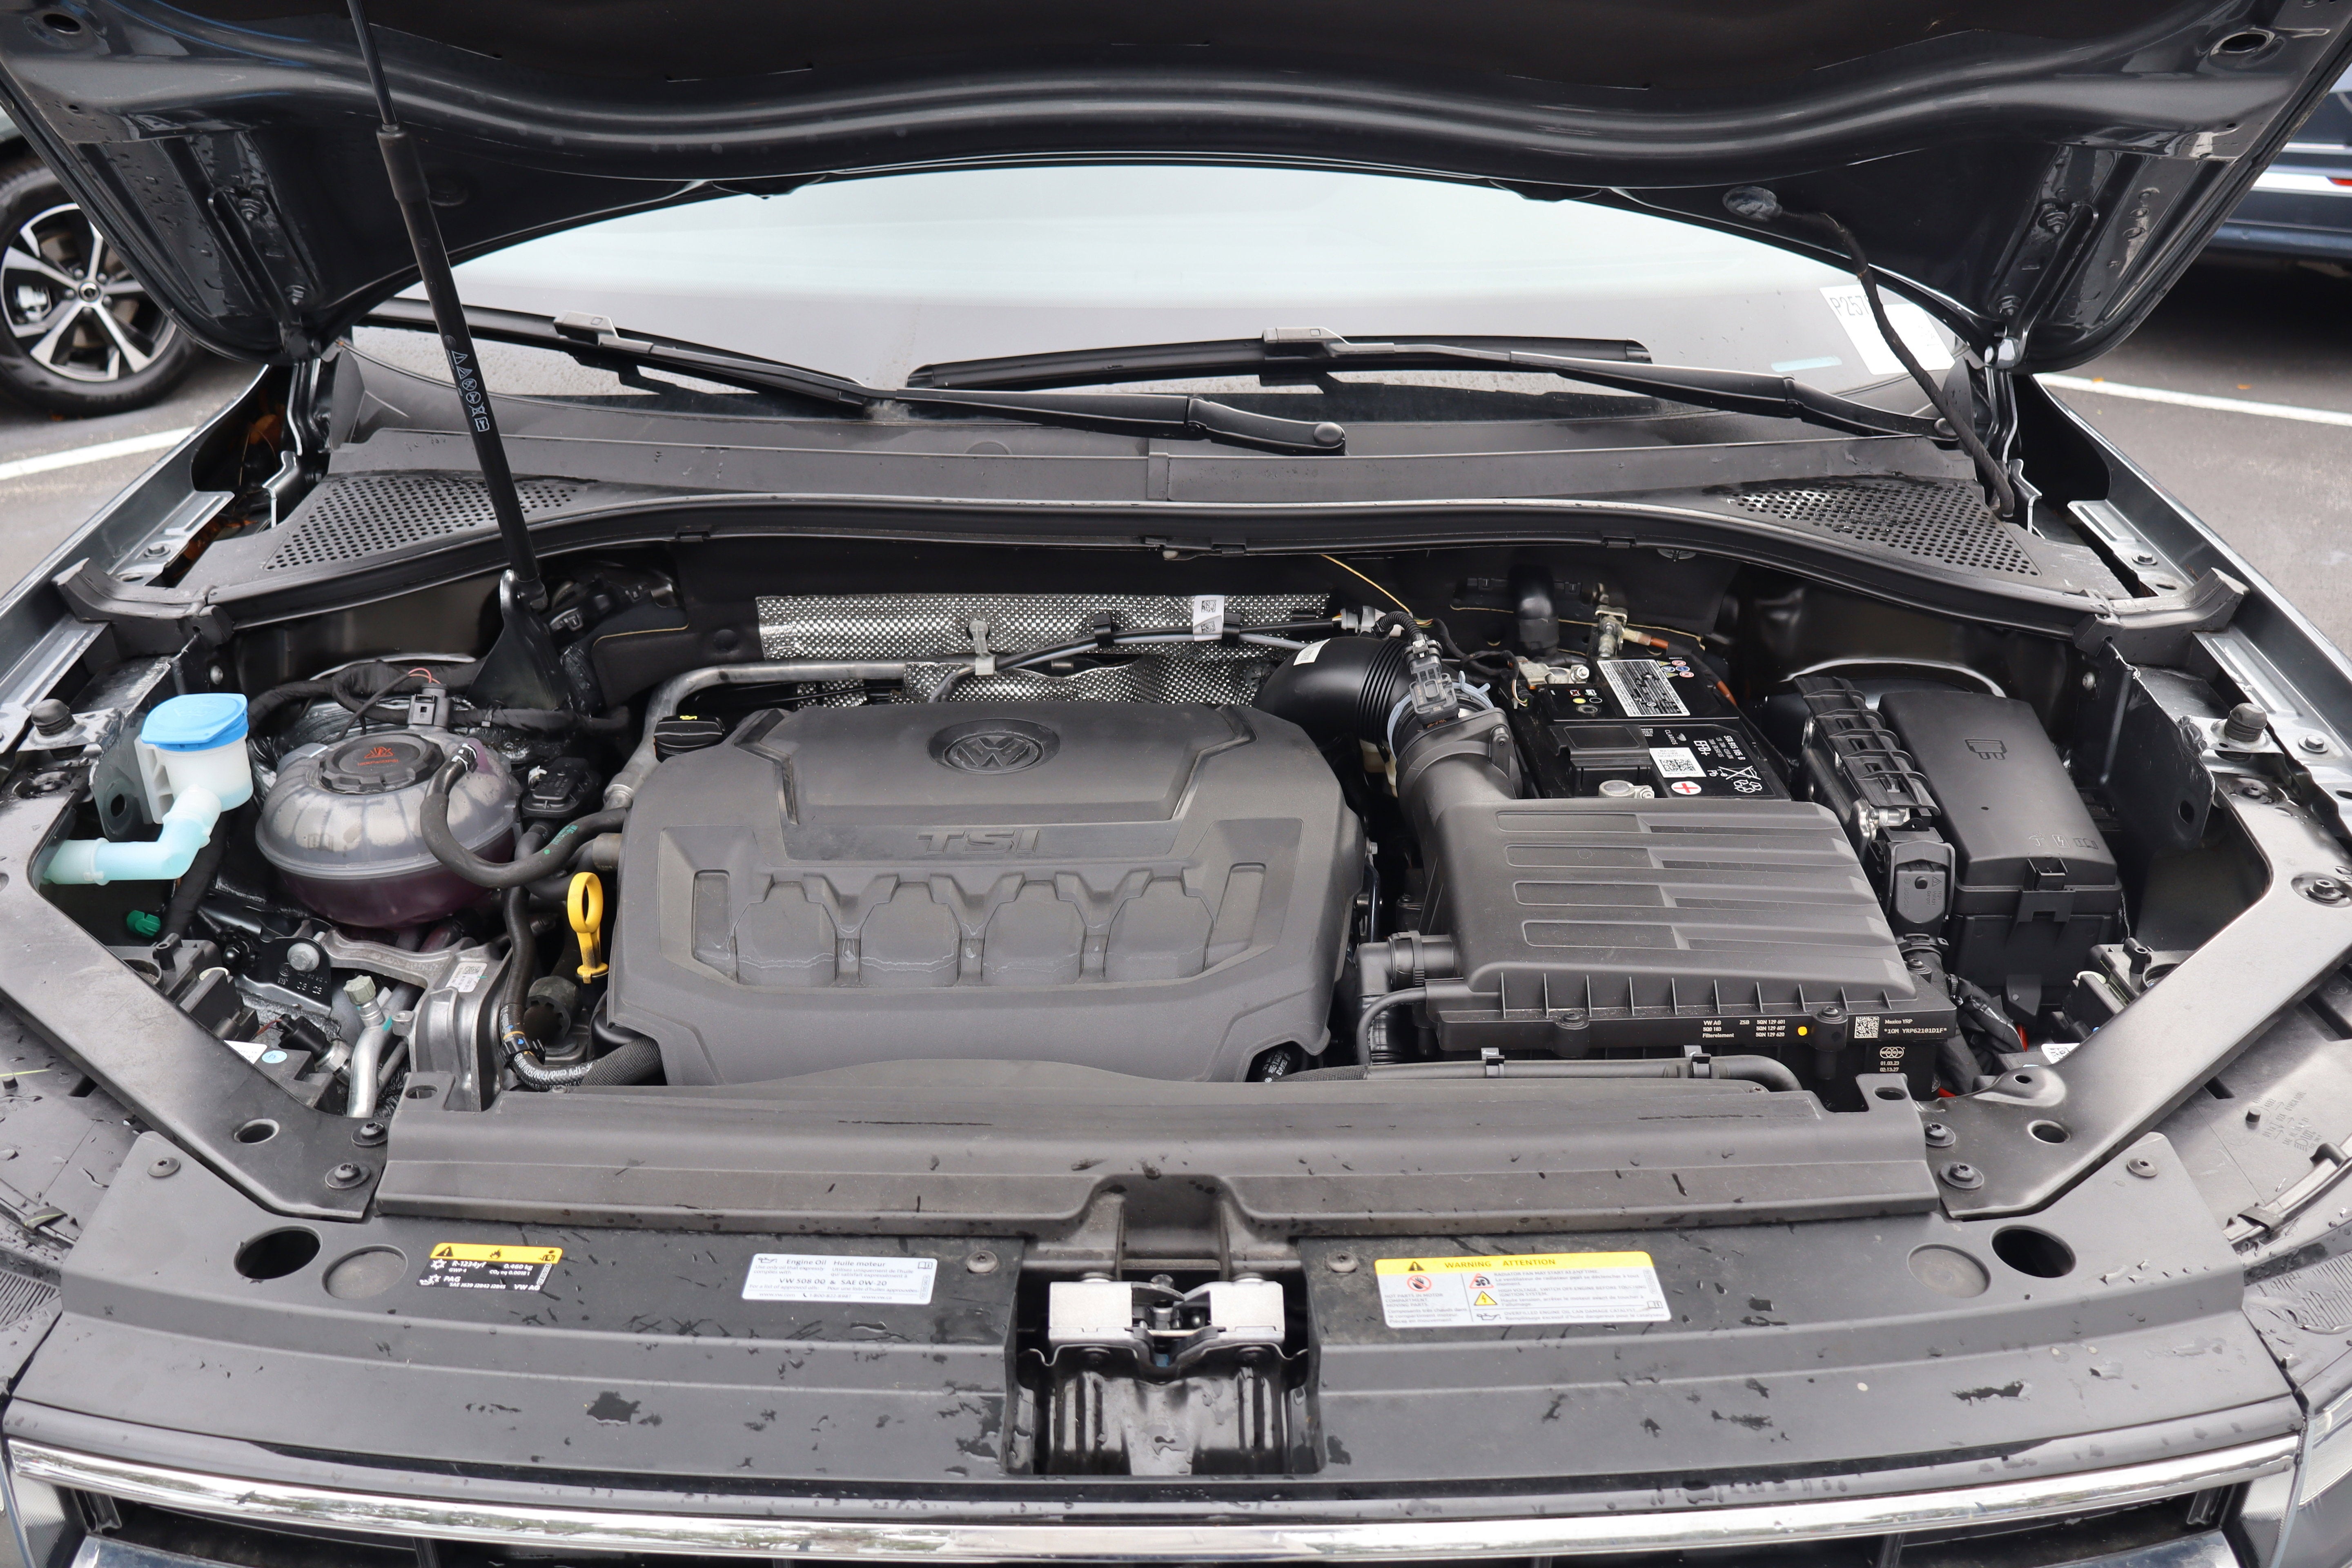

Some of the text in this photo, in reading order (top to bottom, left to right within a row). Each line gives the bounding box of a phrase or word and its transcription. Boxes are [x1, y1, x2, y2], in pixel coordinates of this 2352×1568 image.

[1665, 730, 1678, 745] CLARIOS
[1693, 740, 1711, 756] EFB+
[916, 829, 1041, 855] TSI
[452, 1260, 486, 1269] R-1234yf
